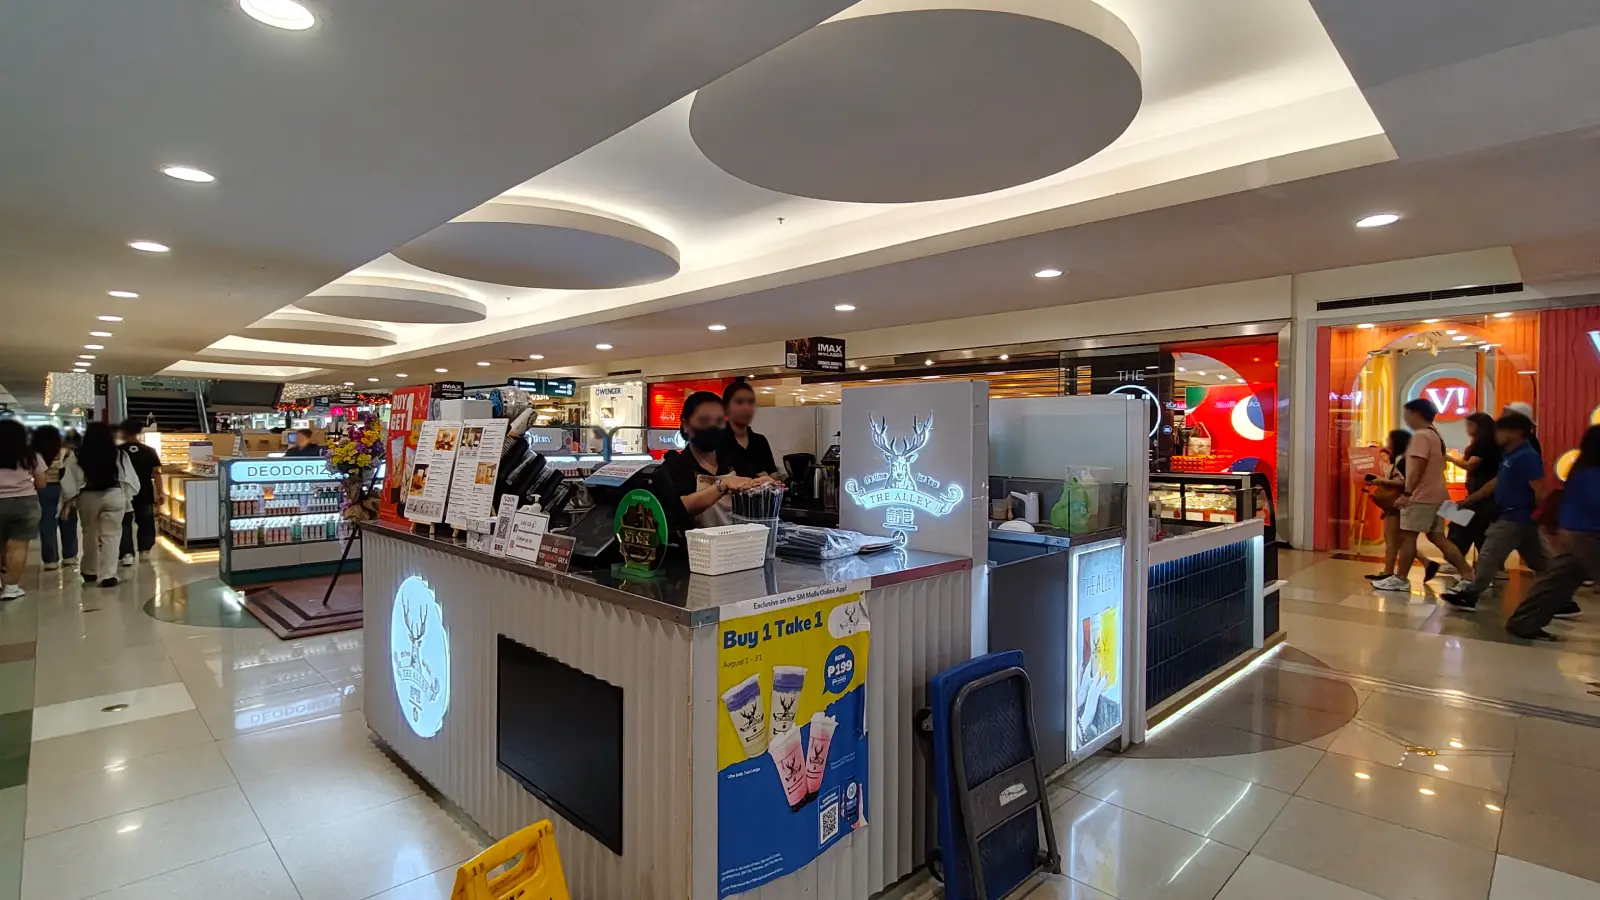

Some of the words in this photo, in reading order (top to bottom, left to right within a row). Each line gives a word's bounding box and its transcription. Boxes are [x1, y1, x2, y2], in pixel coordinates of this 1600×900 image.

[818, 343, 842, 353] IMAX
[1116, 370, 1145, 382] THE
[1425, 387, 1468, 415] V!
[392, 394, 408, 410] BUY
[406, 393, 415, 431] 1
[391, 413, 406, 431] GET
[869, 492, 890, 504] THE
[894, 492, 932, 508] ALLEY
[753, 600, 779, 610] Exclusive
[806, 590, 820, 598] Malls
[820, 588, 835, 596] Online
[835, 584, 848, 593] App!
[723, 630, 759, 650] Buy
[762, 622, 772, 642] 1
[774, 615, 812, 638] Take
[814, 610, 824, 628] 1
[722, 659, 745, 669] August
[754, 654, 763, 663] 31
